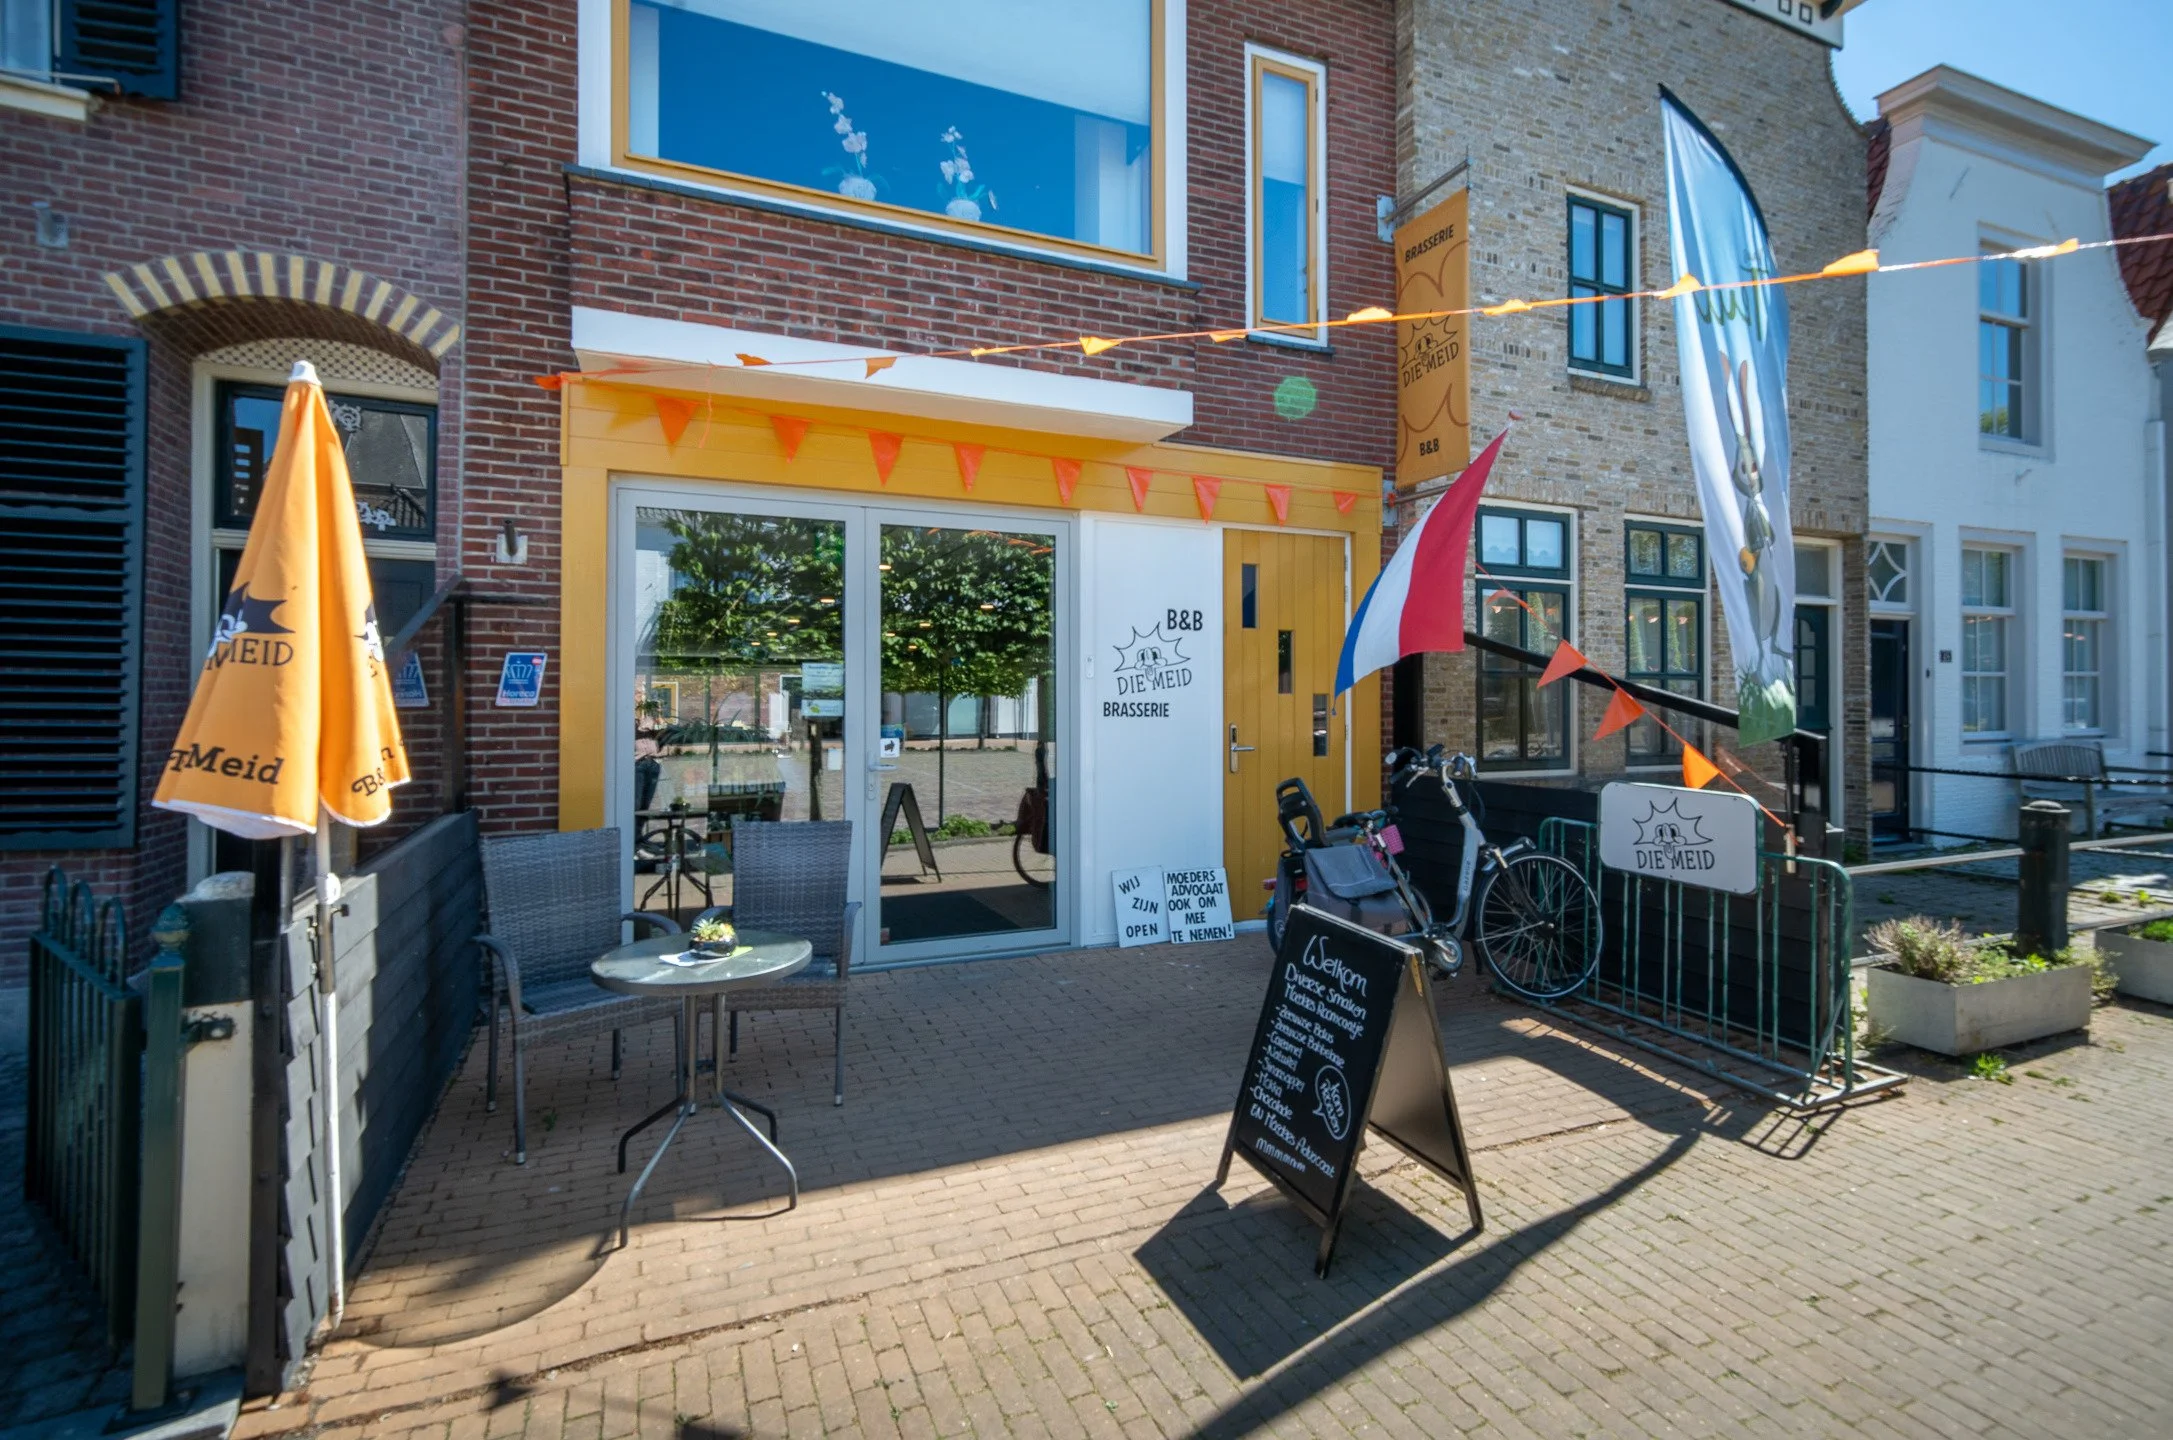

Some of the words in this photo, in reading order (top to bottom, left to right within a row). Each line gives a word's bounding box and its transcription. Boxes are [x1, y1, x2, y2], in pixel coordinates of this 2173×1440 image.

[1404, 223, 1455, 263] BRASSERIE
[1402, 362, 1423, 388] DIE
[1425, 342, 1459, 373] MEID
[1419, 438, 1440, 457] B&B
[1167, 608, 1203, 631] B&B
[1116, 674, 1146, 695] DIE
[1152, 668, 1192, 691] MEID
[1103, 702, 1170, 718] BRASSERIE
[1636, 850, 1665, 869] DIE
[1671, 849, 1715, 870] MEID
[1118, 875, 1140, 894] WIJ
[1166, 870, 1216, 884] MOEDERS
[1171, 883, 1224, 896] ADVOCAAT
[1132, 897, 1158, 914] ZIJN
[1168, 898, 1191, 911] OOK
[1198, 896, 1216, 908] OM
[1185, 912, 1206, 925] MEE
[1126, 923, 1158, 938] OPEN
[1171, 930, 1183, 942] TE
[1189, 924, 1232, 941] NEMEN!
[1303, 935, 1367, 997] Welkom
[1284, 963, 1326, 997] Diverse
